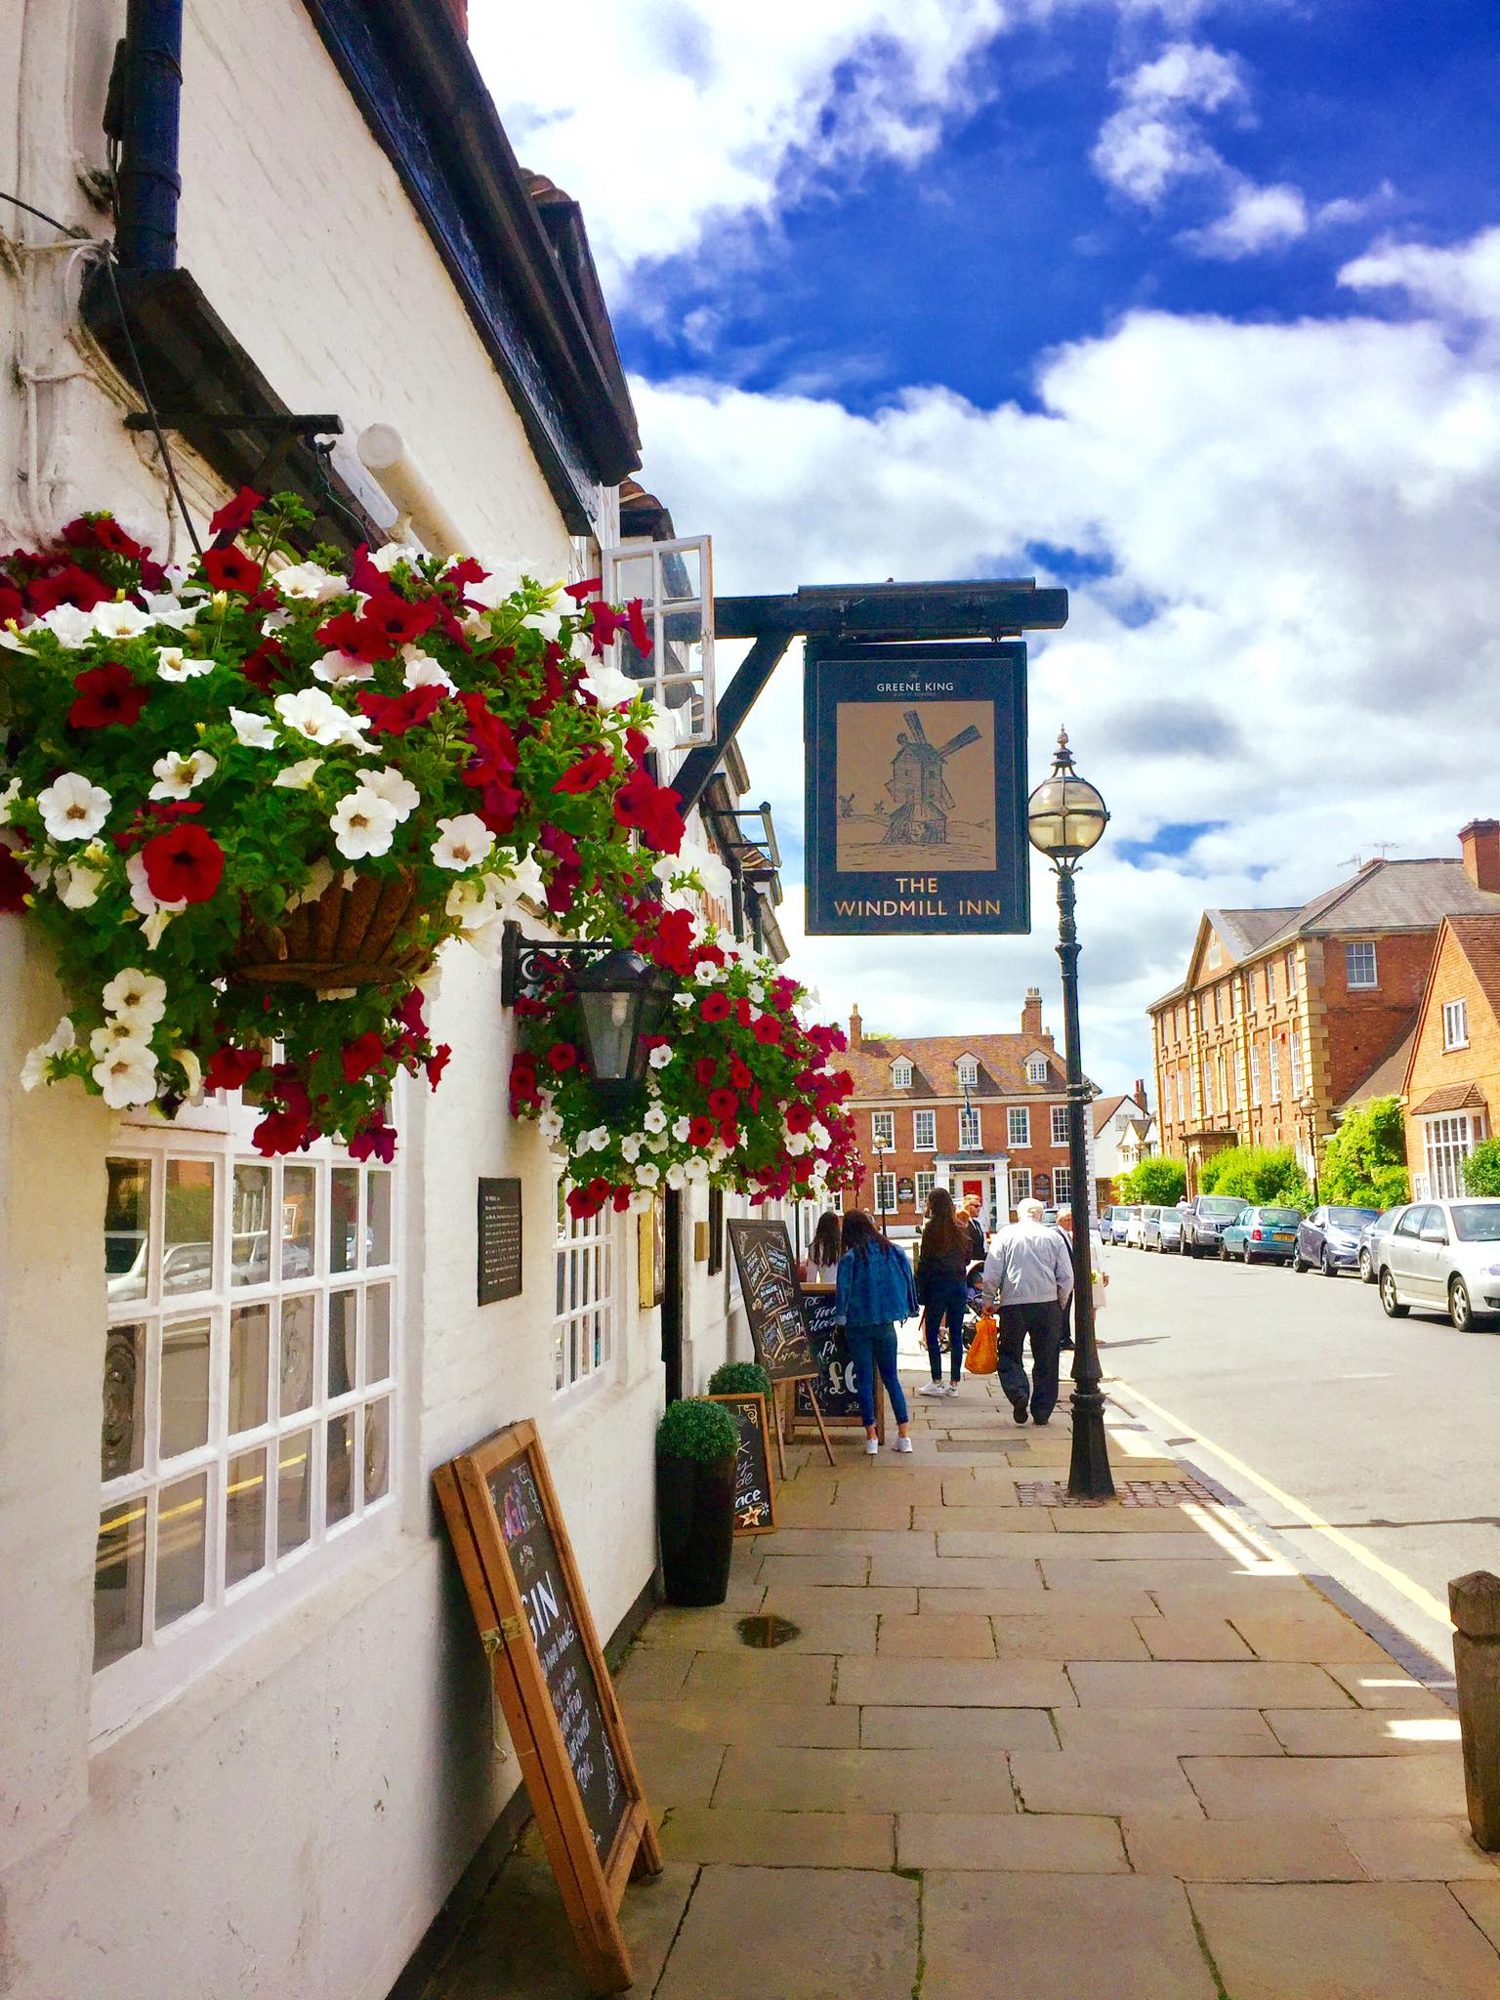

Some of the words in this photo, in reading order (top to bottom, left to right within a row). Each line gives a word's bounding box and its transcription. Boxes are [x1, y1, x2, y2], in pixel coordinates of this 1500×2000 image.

[876, 683, 921, 692] GREENE
[925, 682, 954, 691] KING
[896, 878, 938, 893] THE
[834, 900, 948, 916] WINDMILL
[959, 899, 1000, 915] INN
